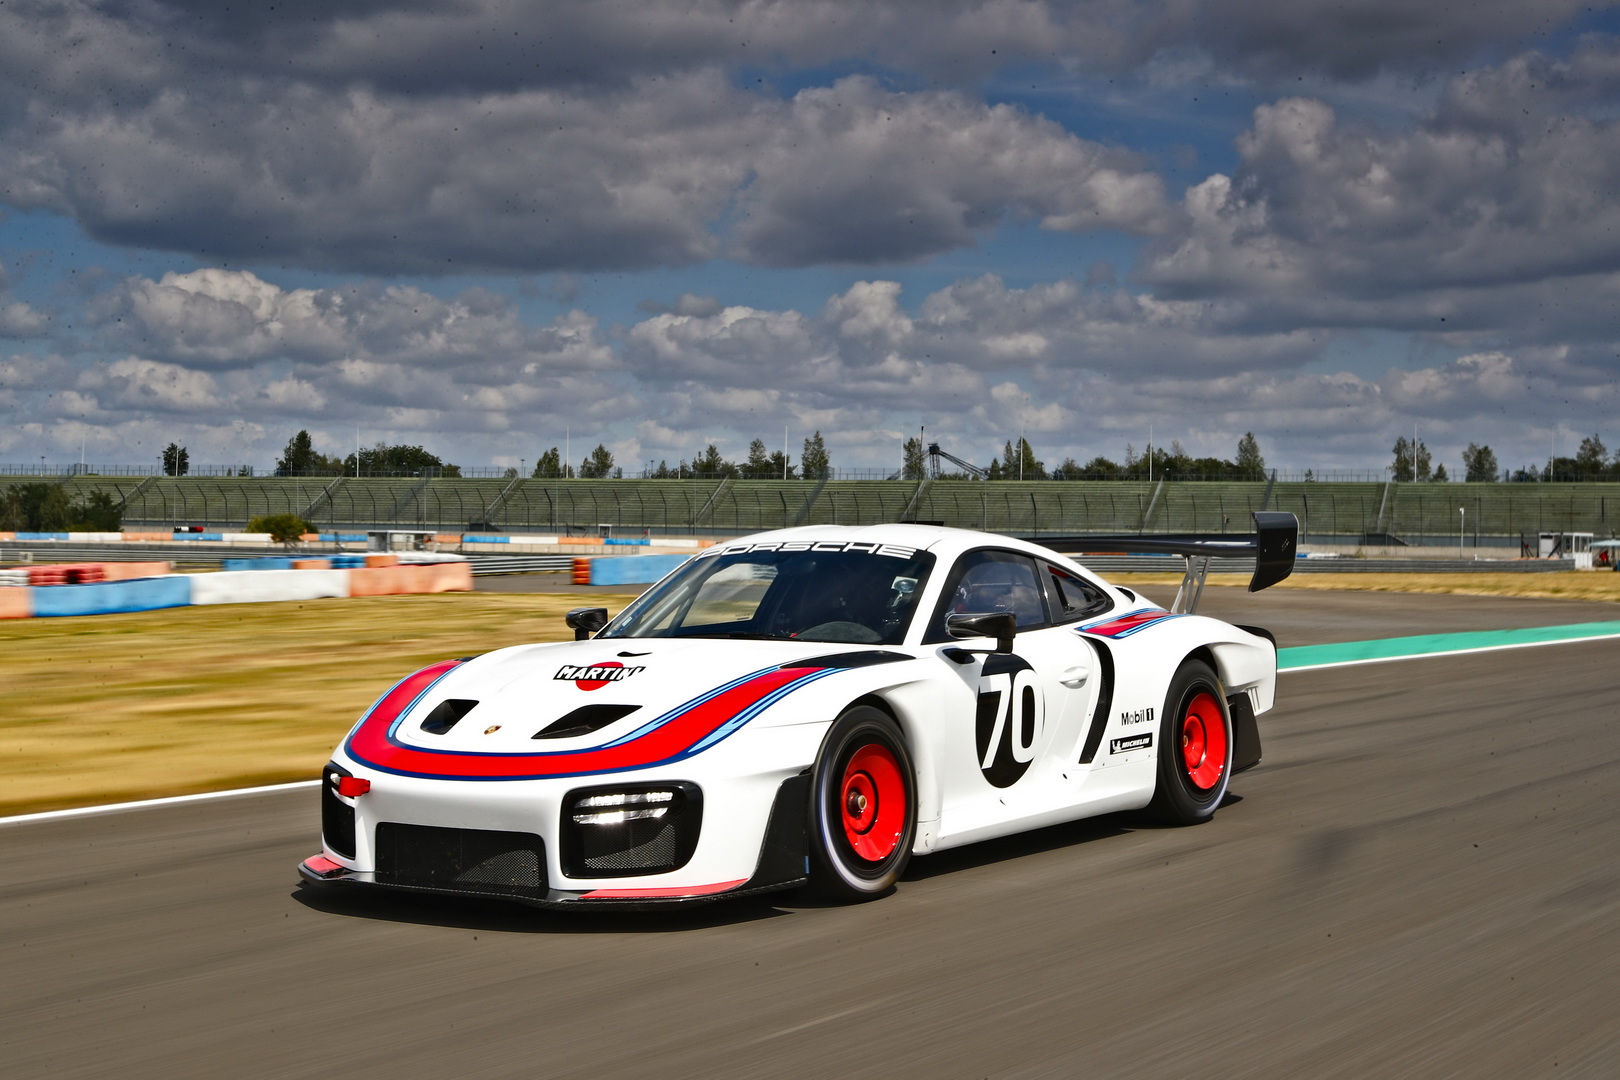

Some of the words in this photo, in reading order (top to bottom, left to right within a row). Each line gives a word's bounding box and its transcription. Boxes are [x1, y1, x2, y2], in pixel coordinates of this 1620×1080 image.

[695, 541, 917, 560] PORSCHE
[979, 669, 1042, 769] 70
[1122, 710, 1144, 725] Mobil
[1147, 708, 1154, 721] 1
[1122, 738, 1149, 748] MICHELIN
